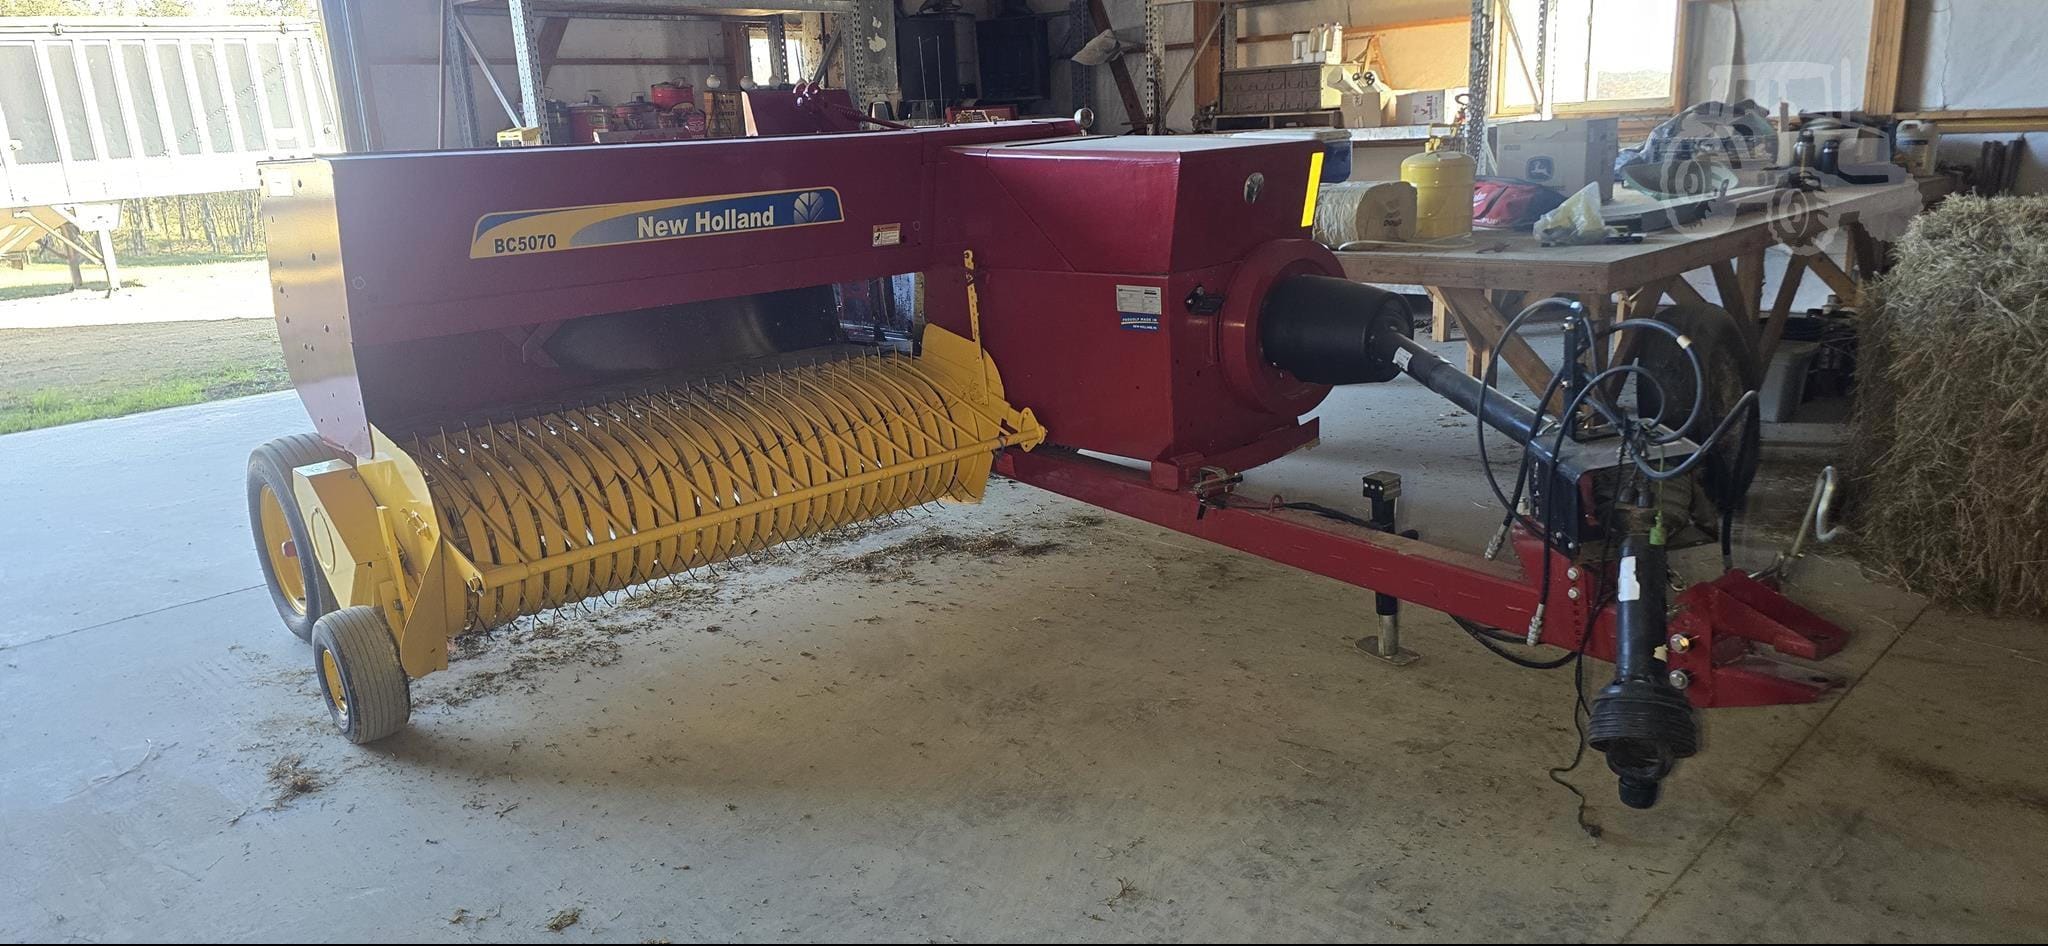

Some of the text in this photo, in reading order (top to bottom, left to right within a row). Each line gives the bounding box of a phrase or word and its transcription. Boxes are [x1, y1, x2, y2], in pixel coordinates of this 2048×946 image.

[637, 205, 774, 239] New Holland
[494, 233, 557, 254] BC5070
